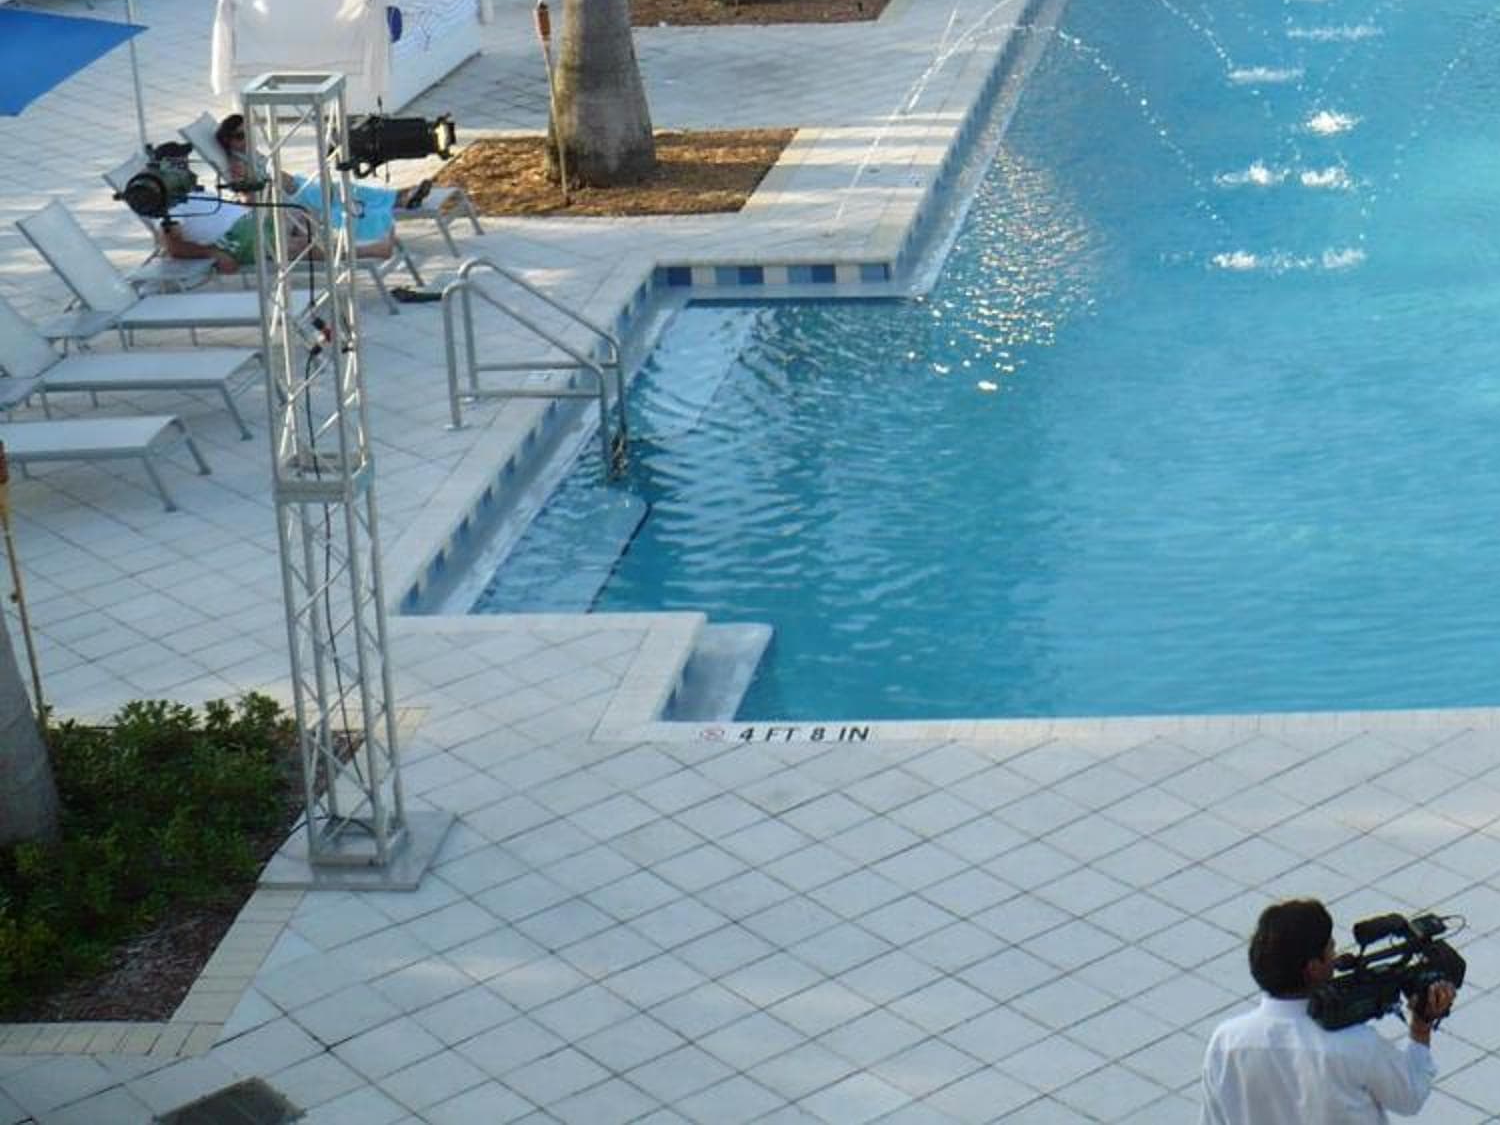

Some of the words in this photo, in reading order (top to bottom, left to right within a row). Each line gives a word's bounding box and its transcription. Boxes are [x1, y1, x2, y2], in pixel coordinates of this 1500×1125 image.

[739, 727, 754, 743] 4
[765, 726, 799, 742] FT
[810, 726, 825, 742] 8
[838, 726, 870, 742] IN
